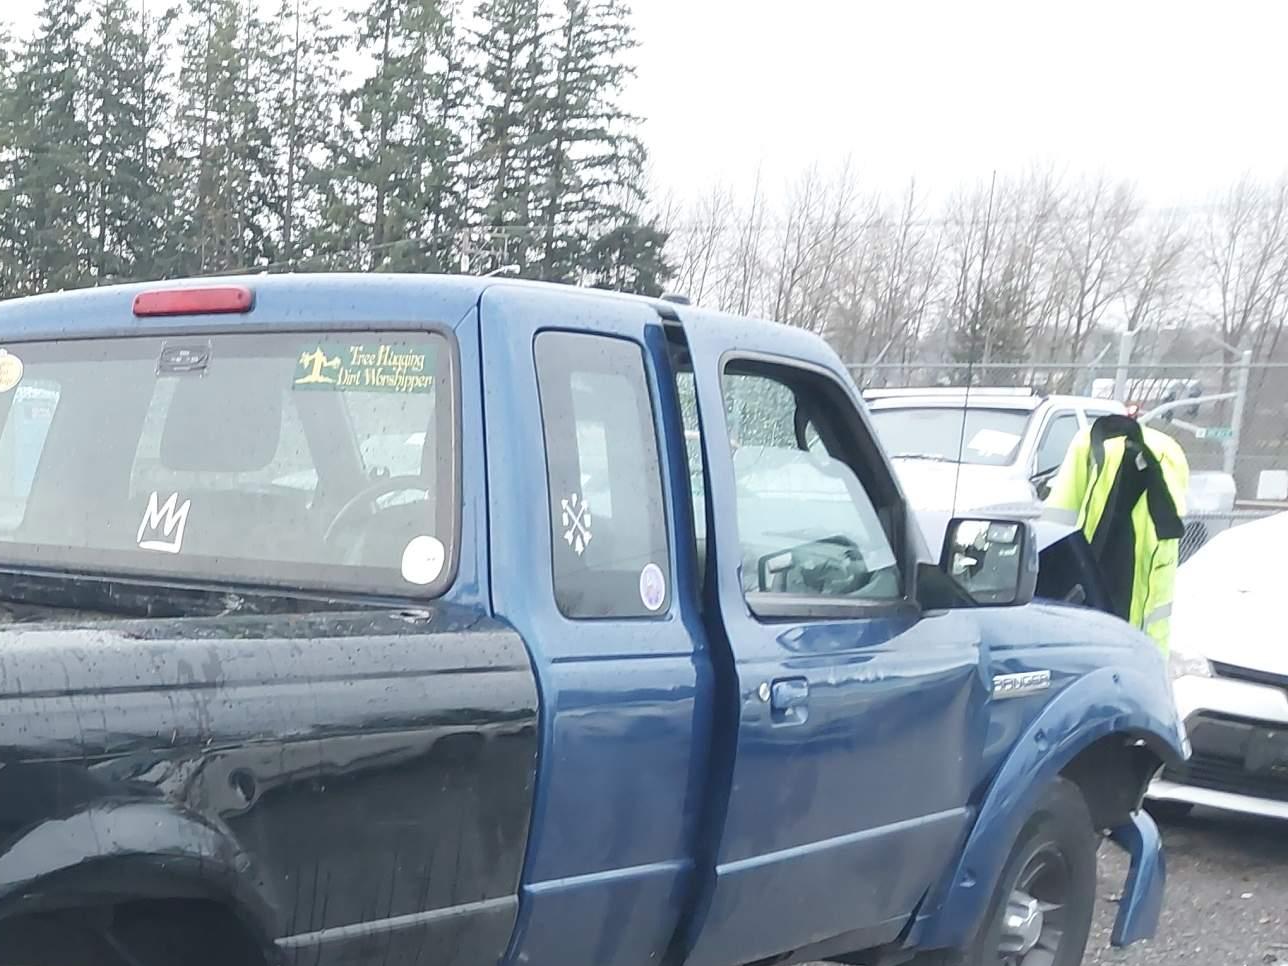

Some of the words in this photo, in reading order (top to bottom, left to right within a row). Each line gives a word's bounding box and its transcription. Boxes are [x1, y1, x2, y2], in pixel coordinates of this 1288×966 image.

[349, 345, 376, 366] Tree
[376, 344, 426, 371] Hugging
[336, 367, 361, 386] Dirt
[364, 367, 433, 393] Worshipper
[993, 672, 1050, 691] RANGER
